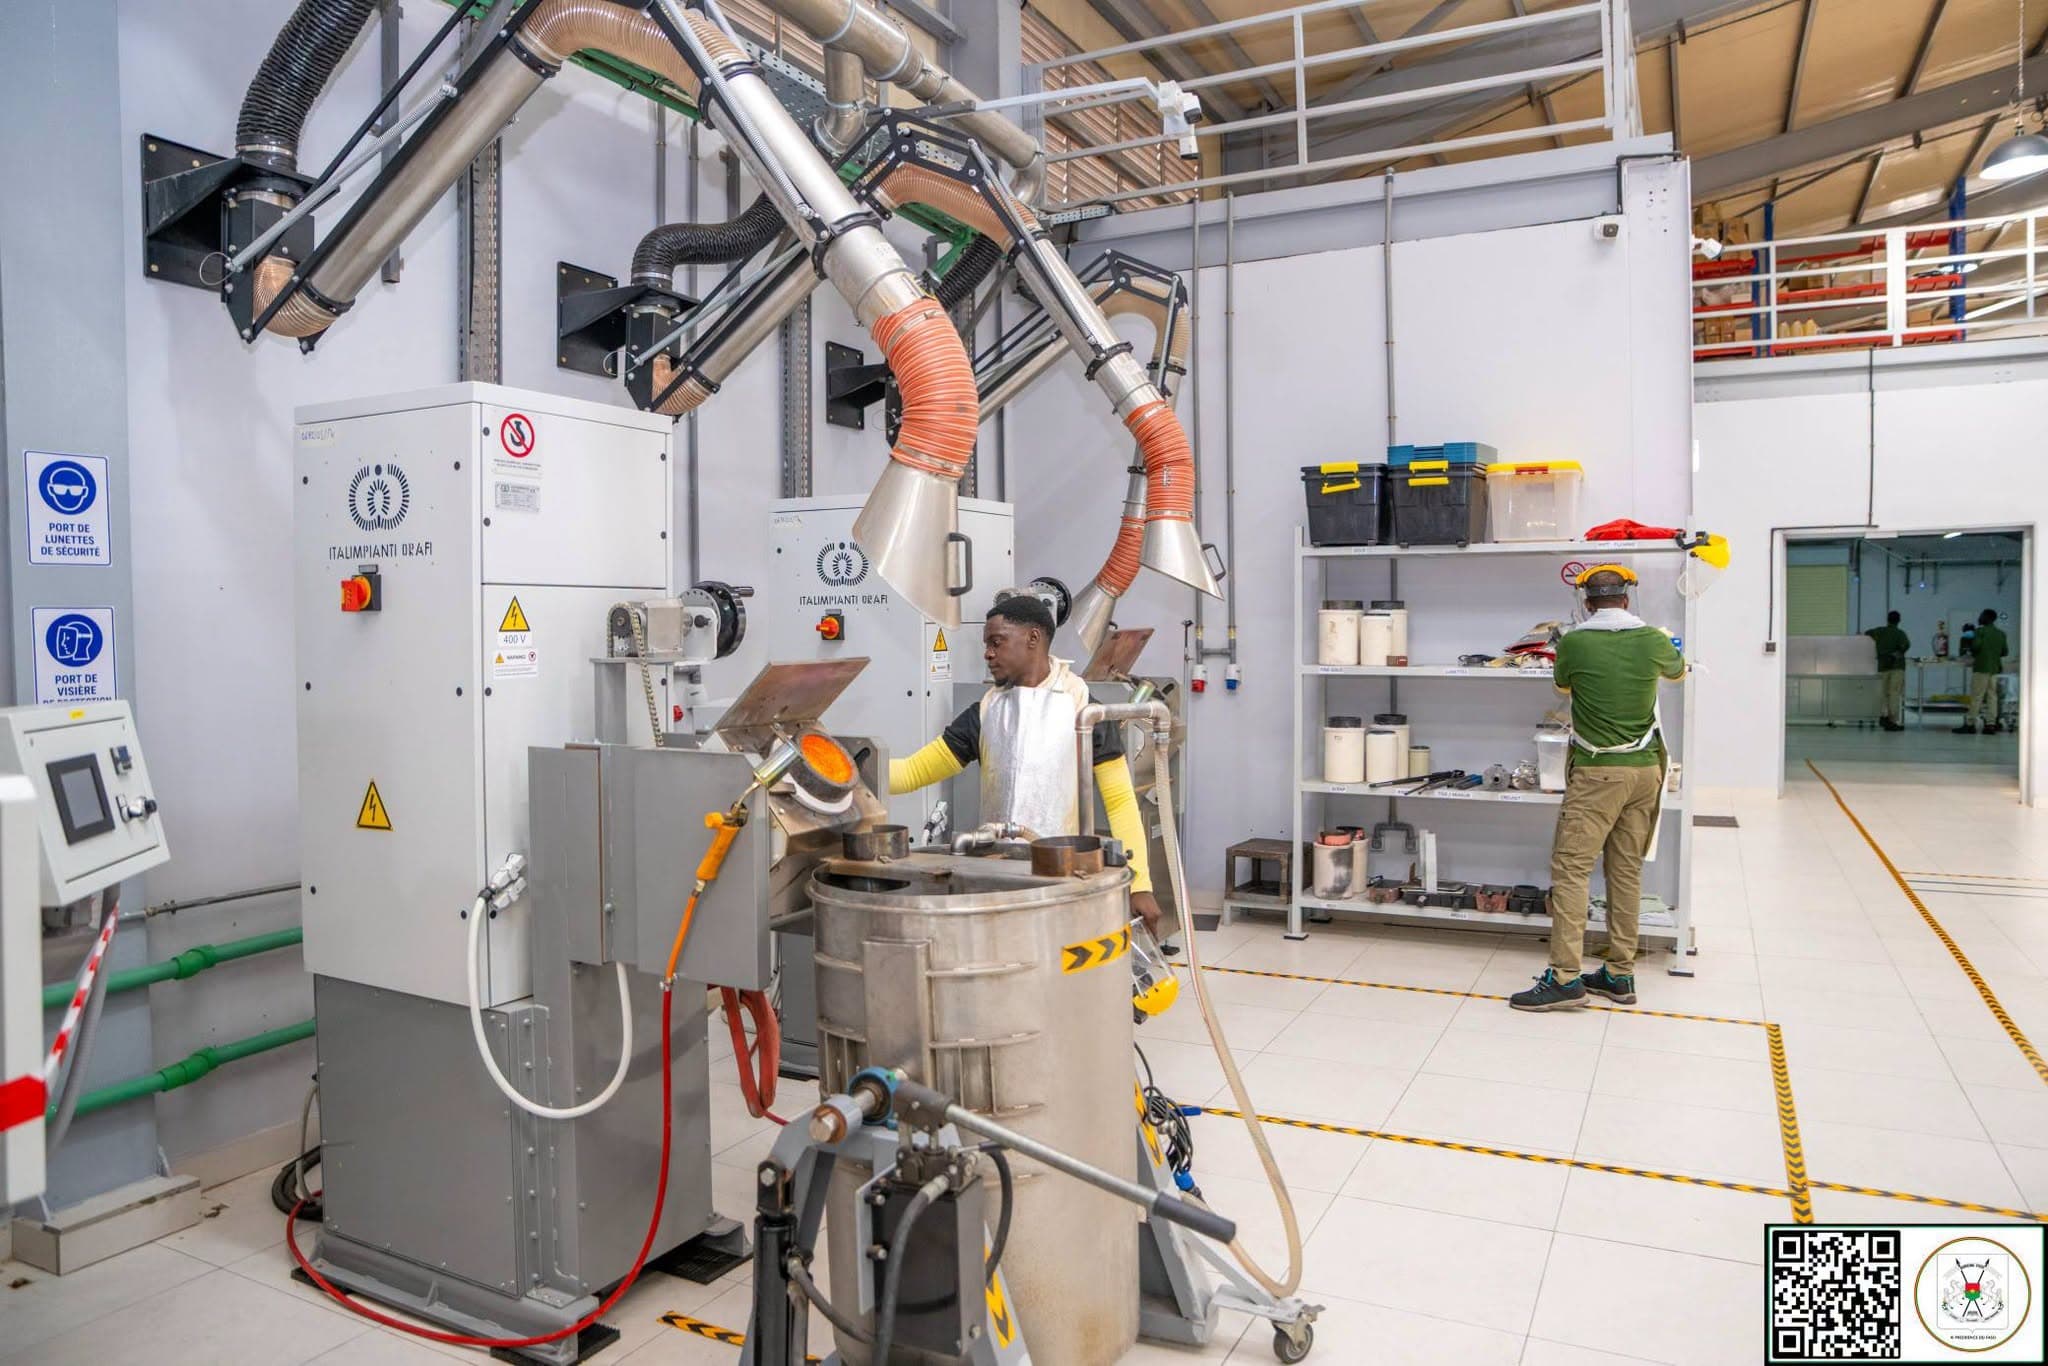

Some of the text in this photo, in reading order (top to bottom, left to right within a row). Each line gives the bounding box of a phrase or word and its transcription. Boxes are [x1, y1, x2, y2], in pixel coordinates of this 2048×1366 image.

[49, 523, 90, 533] PORT DE
[45, 535, 95, 545] LUNETTES
[41, 545, 100, 557] DE SÉCURITÉ
[329, 543, 397, 560] ITALIMPIANTI
[504, 634, 527, 644] 400 V
[55, 673, 98, 685] PORT DE
[57, 685, 97, 697] VISIÈRE
